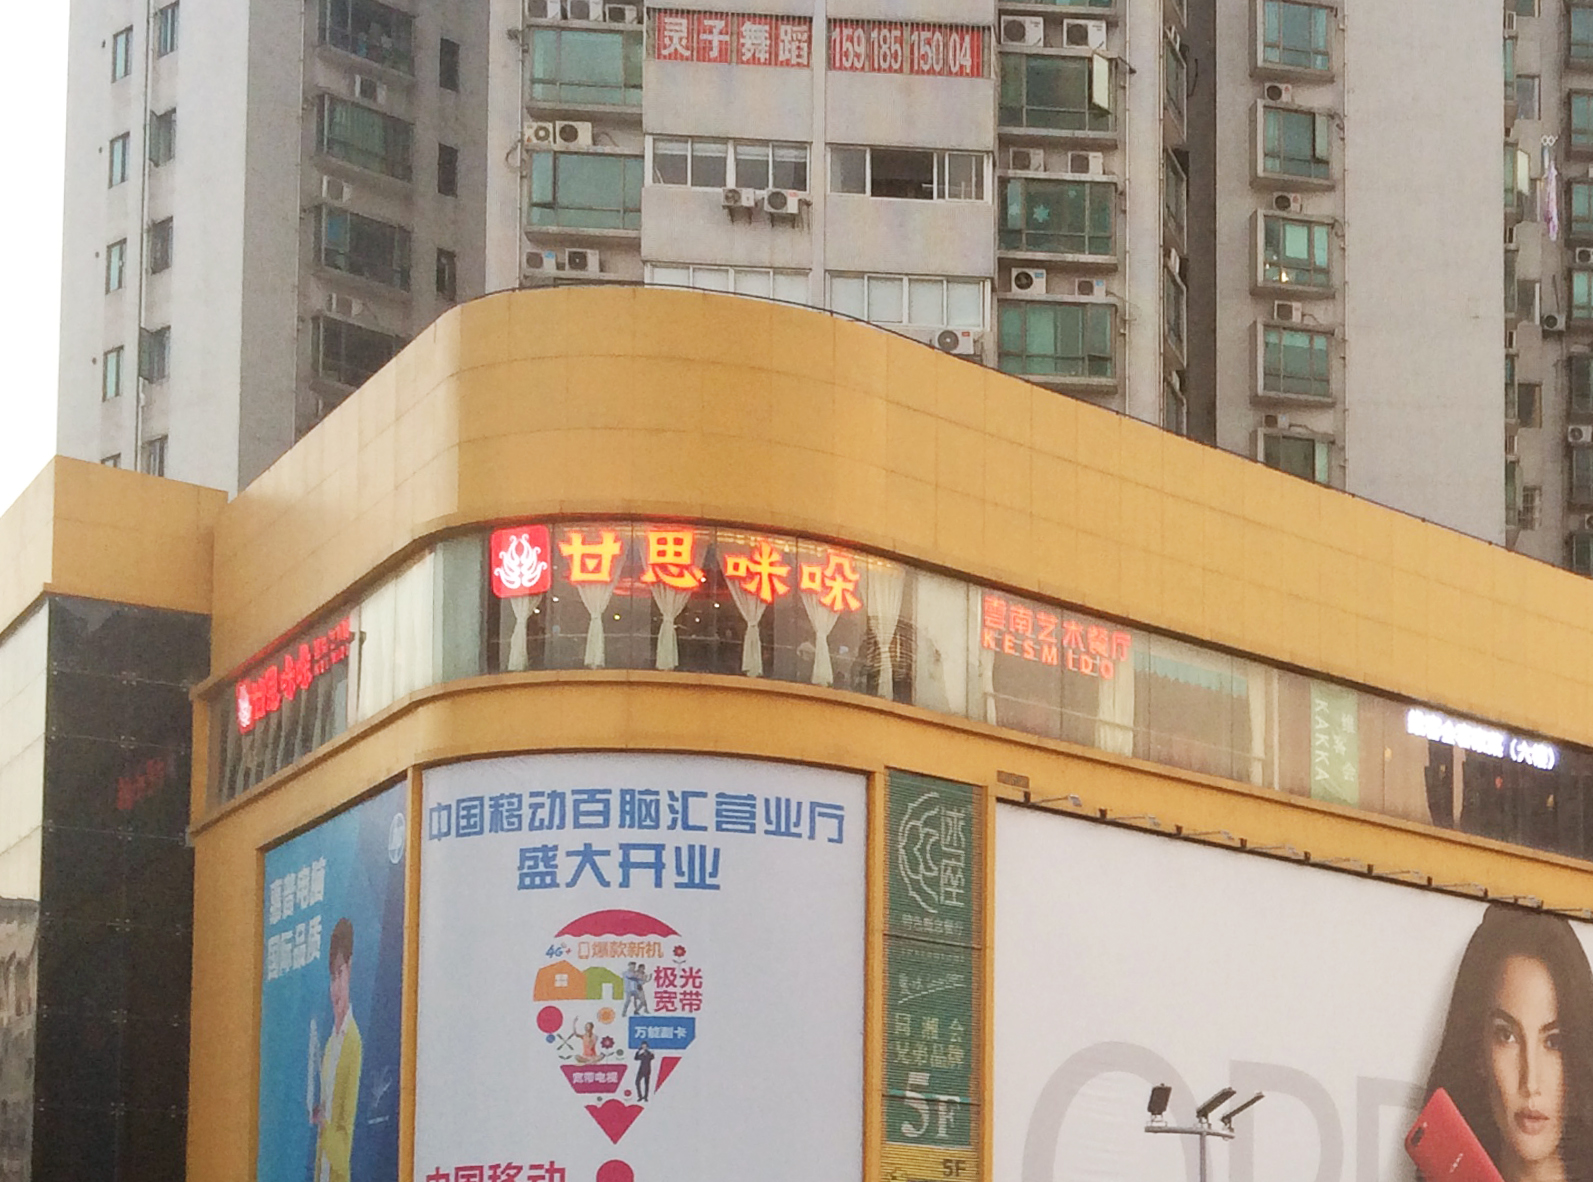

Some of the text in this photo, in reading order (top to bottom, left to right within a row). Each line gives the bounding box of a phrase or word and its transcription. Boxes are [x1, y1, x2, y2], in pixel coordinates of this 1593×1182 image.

[663, 17, 808, 65] 灵子舞蹈
[559, 528, 862, 611] 甘思咪哚
[428, 789, 845, 843] 中国移动百脑汇营业厅
[517, 843, 721, 891] 盛大开业
[591, 941, 664, 959] 爆款新机
[654, 966, 702, 990] 极光
[654, 990, 702, 1013] 宽带
[634, 1025, 687, 1039] 万能副卡
